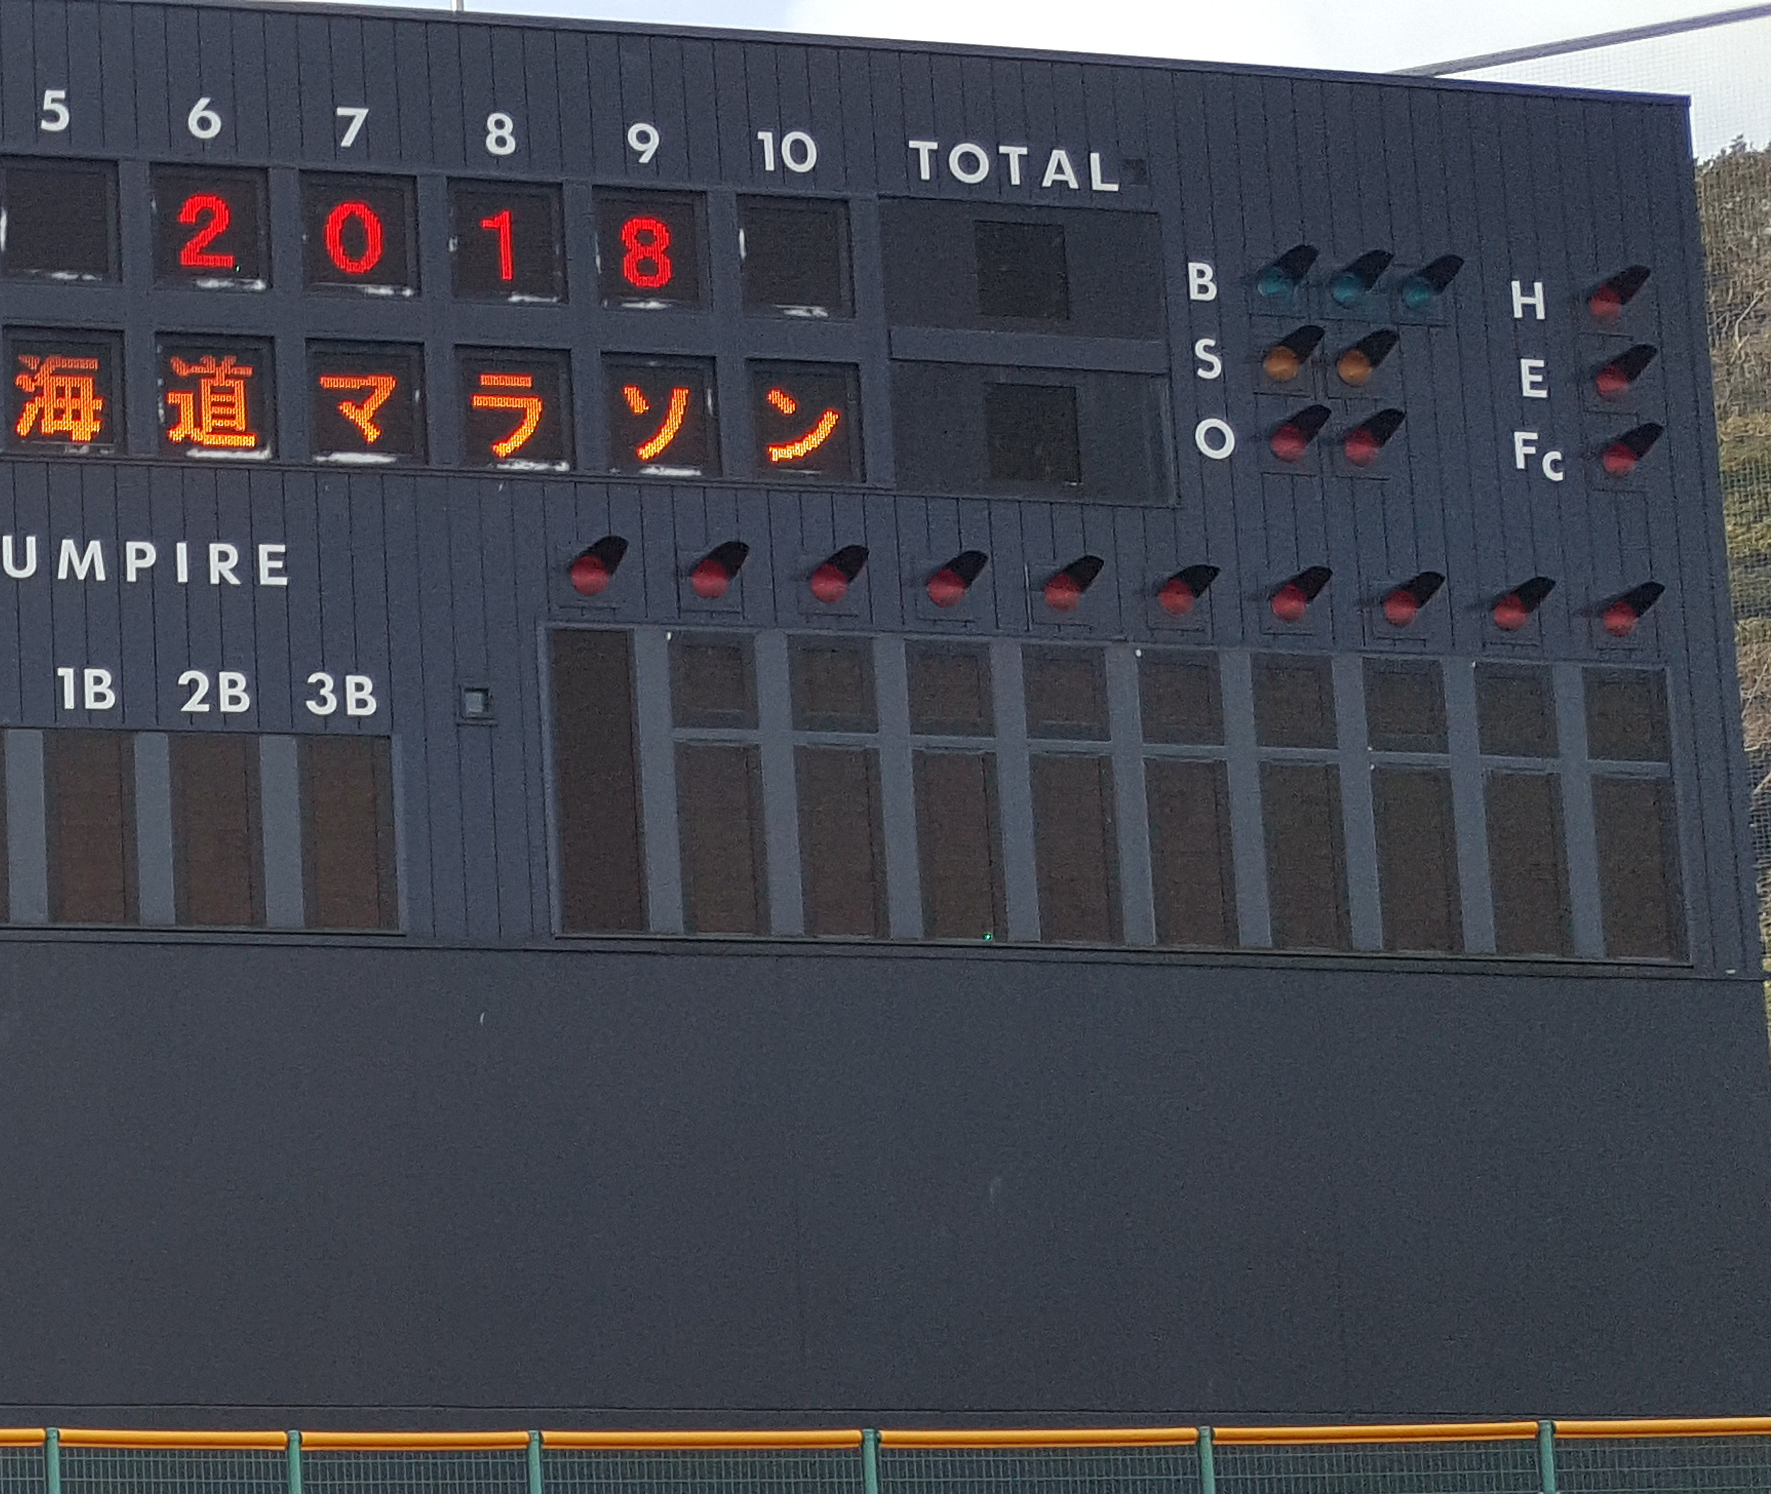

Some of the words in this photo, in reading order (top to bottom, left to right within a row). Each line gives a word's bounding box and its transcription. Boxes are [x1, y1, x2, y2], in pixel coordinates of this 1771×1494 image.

[40, 89, 70, 132] 5
[187, 97, 222, 139] 6
[336, 106, 369, 147] 7
[485, 112, 516, 156] 8
[627, 122, 660, 164] 9
[757, 131, 817, 173] 10
[908, 140, 1119, 192] TOTAL
[178, 194, 672, 288] 2018
[1187, 262, 1218, 301] B
[1511, 280, 1546, 320] H
[1194, 338, 1222, 380] S
[1520, 358, 1548, 398] E
[1195, 418, 1235, 460] O
[2, 534, 288, 586] UMPIRE
[57, 667, 116, 710] 1B
[177, 669, 251, 713] 2B
[305, 671, 377, 716] 3B
